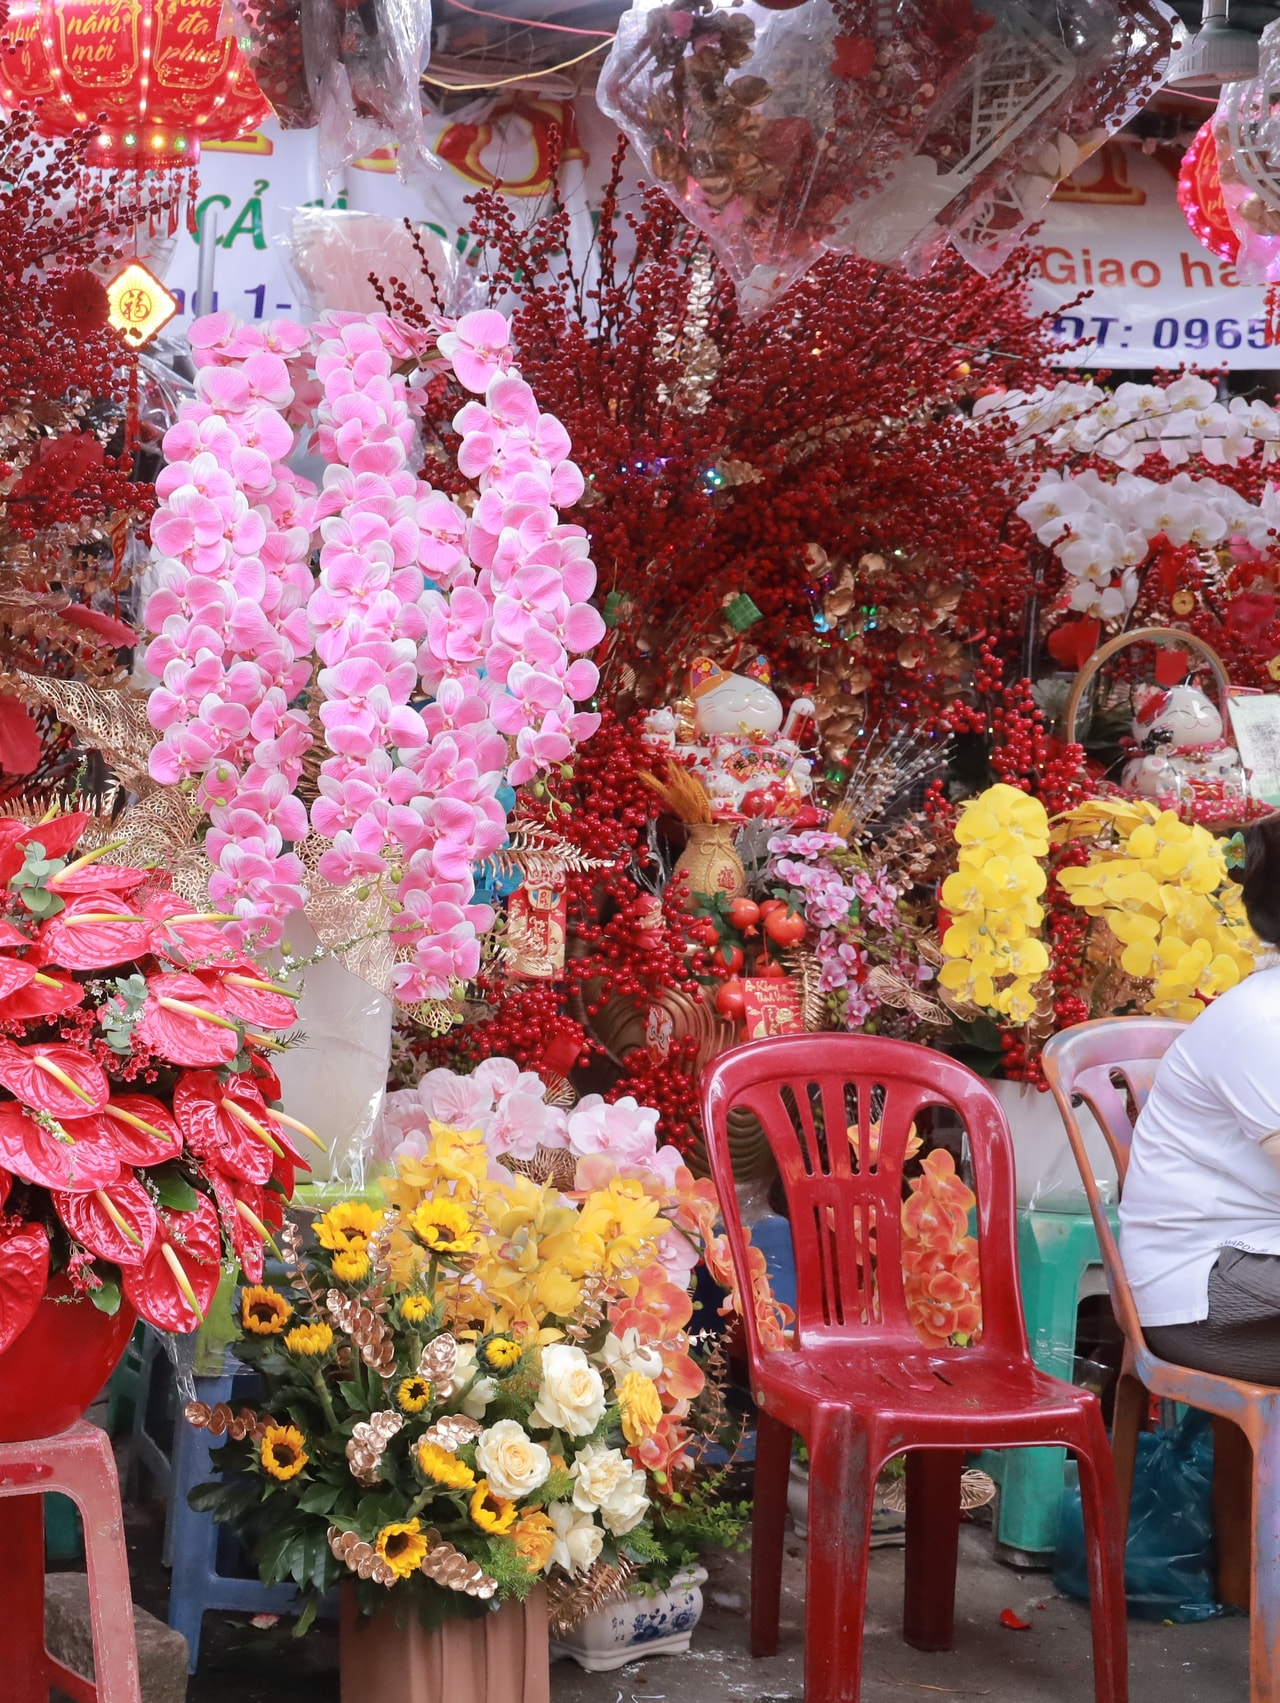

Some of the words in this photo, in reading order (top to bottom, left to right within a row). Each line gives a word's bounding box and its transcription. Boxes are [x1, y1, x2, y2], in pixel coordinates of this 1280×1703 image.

[67, 8, 122, 36] năm
[176, 9, 212, 35] đa
[71, 36, 117, 62] mới
[1040, 247, 1162, 288] Giao
